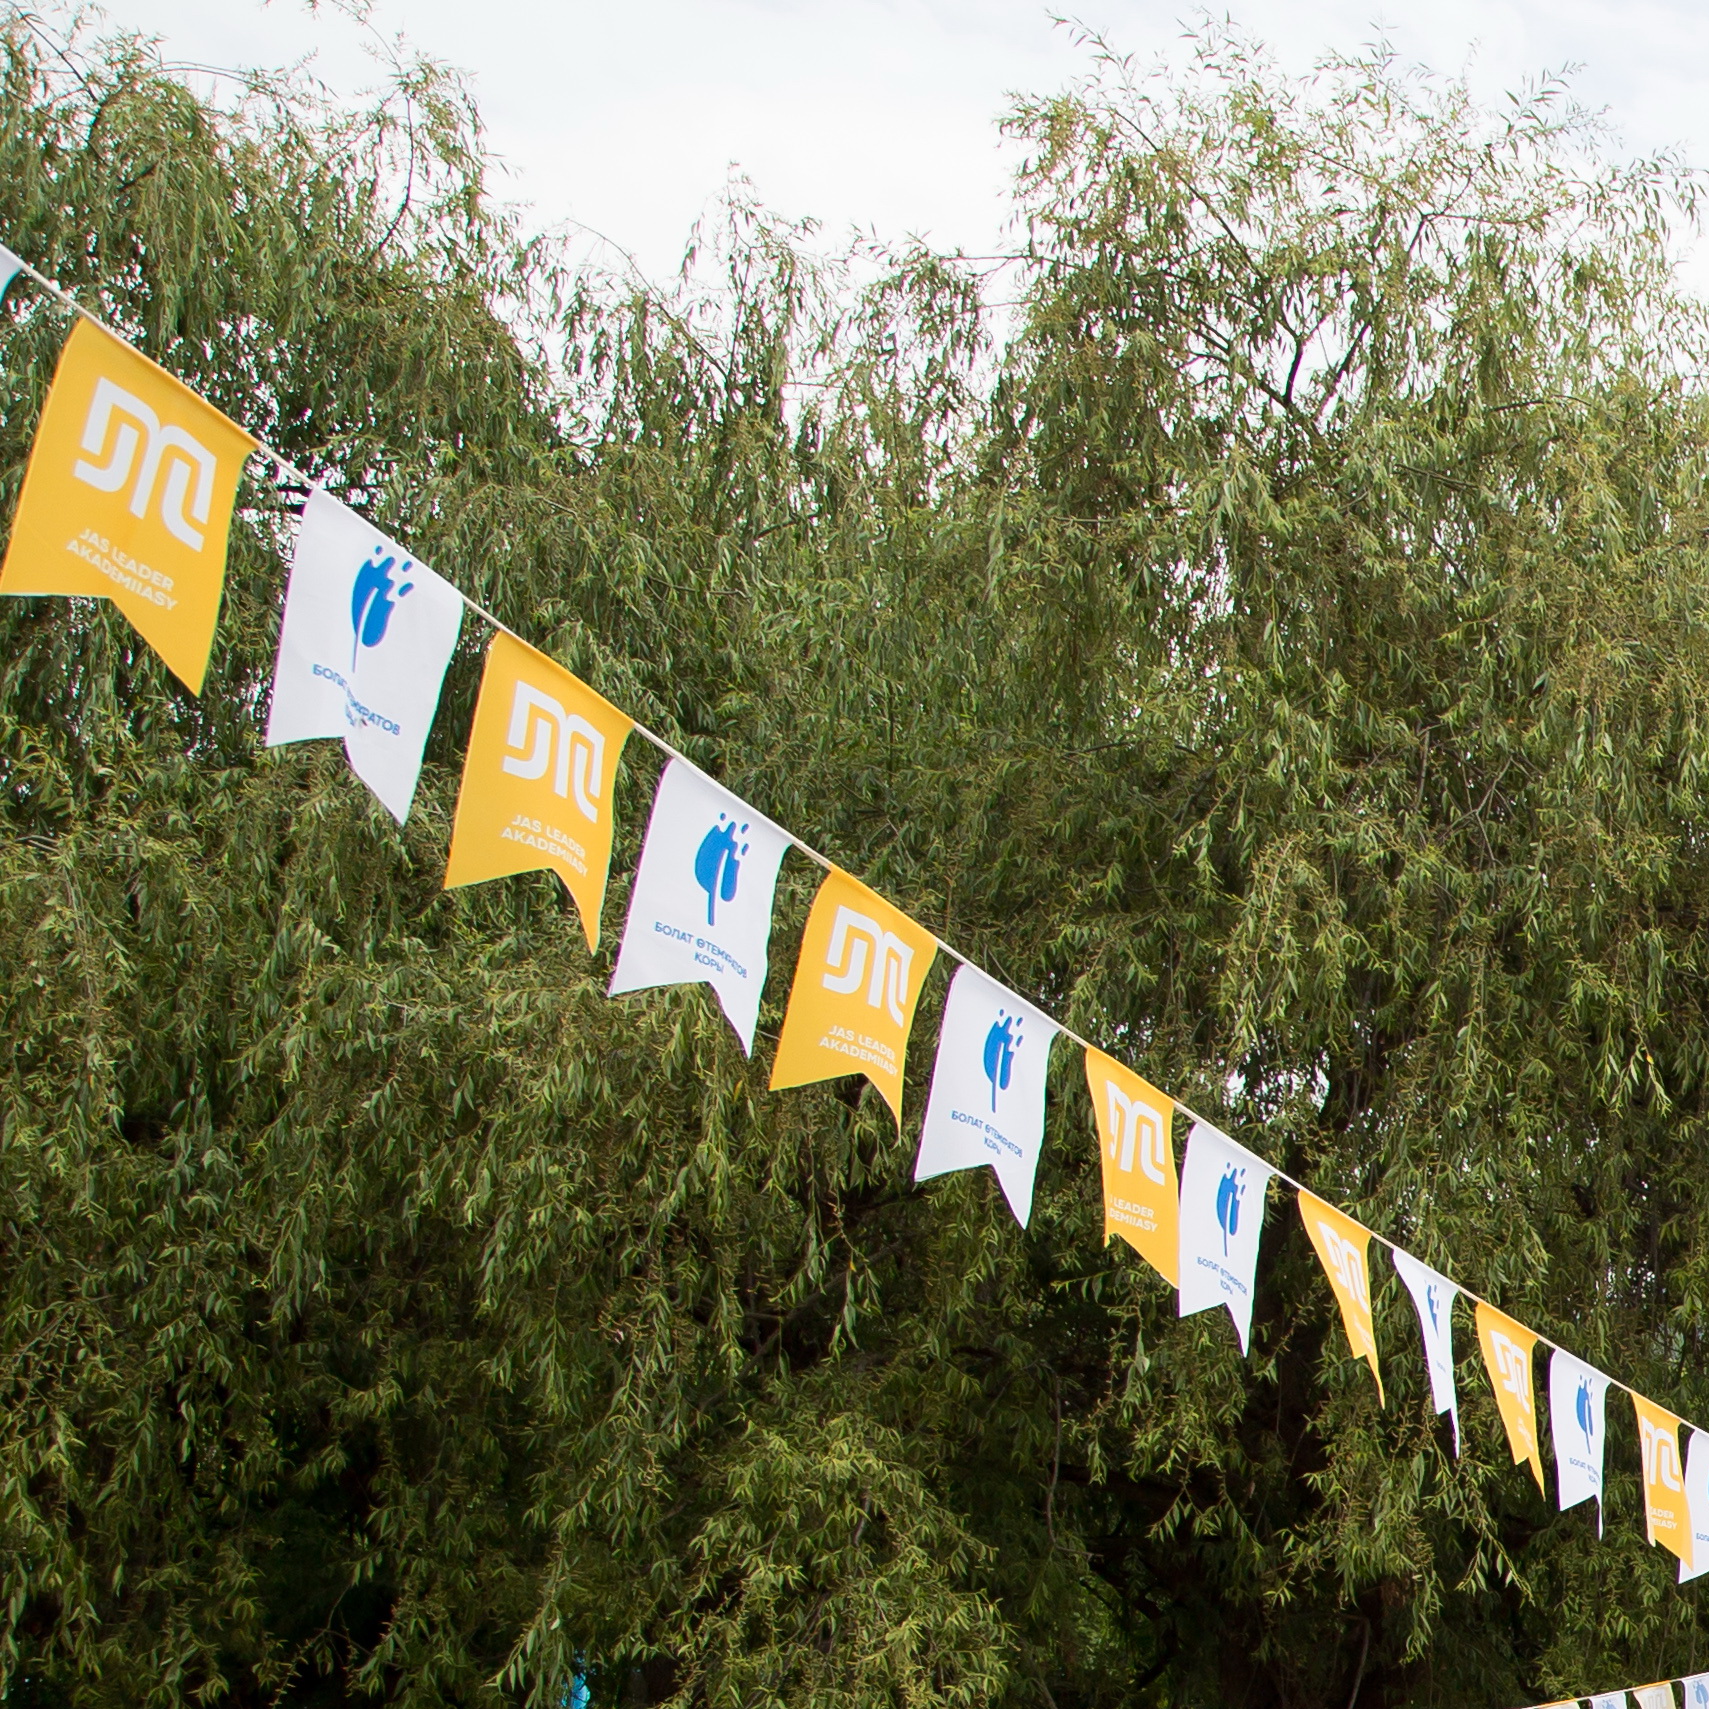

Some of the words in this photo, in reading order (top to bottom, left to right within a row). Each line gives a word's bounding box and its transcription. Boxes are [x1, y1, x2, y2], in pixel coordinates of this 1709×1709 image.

[79, 528, 110, 553] JAS
[112, 546, 174, 592] LEADER
[511, 814, 542, 833] JAS
[655, 921, 694, 944] БОЛАТ
[828, 1025, 855, 1041] JAS
[1113, 1198, 1155, 1219] LEADER
